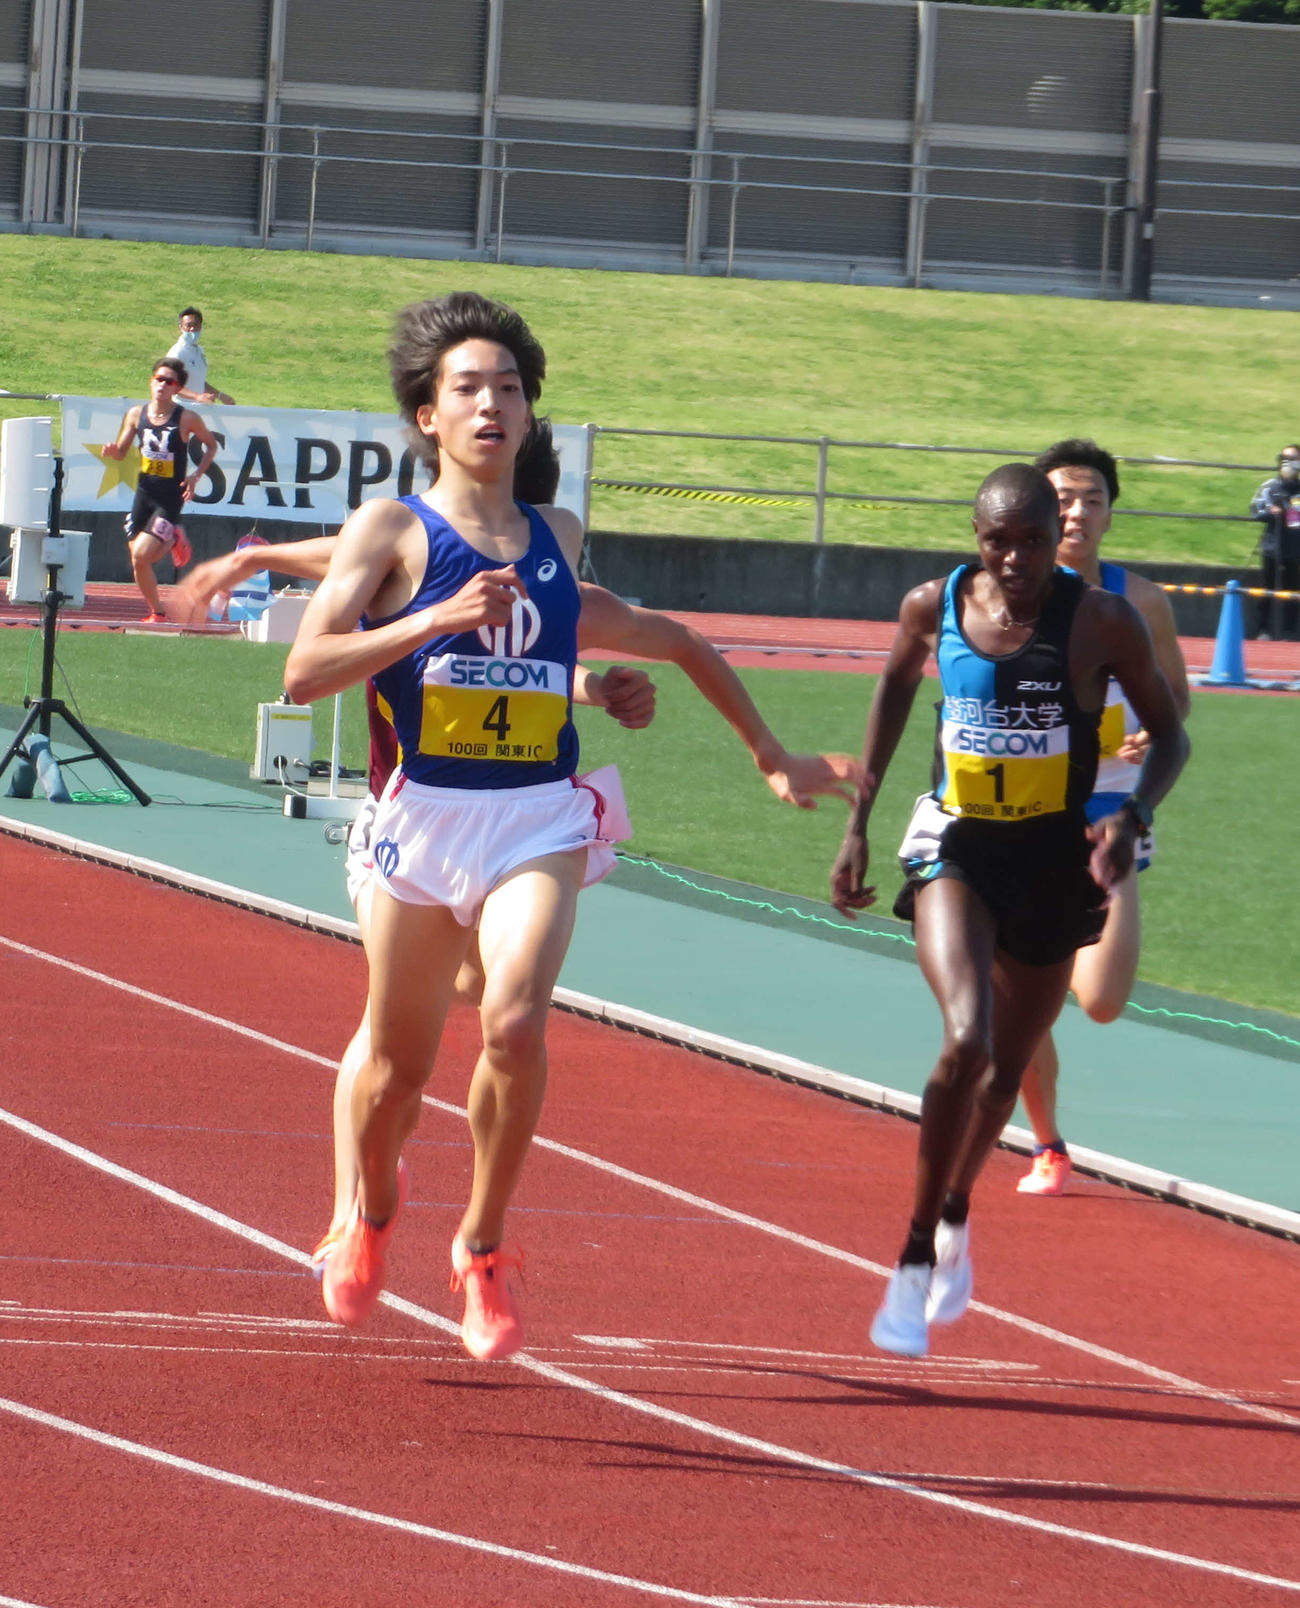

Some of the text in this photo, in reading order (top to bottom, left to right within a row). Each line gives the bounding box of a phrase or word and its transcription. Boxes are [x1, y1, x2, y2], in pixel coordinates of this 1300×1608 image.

[450, 660, 549, 688] SECOM
[482, 696, 511, 741] 4
[448, 742, 543, 758] 100回 関東IC
[958, 728, 1048, 756] SECOM
[985, 763, 1005, 803] 1
[962, 802, 994, 816] 00回
